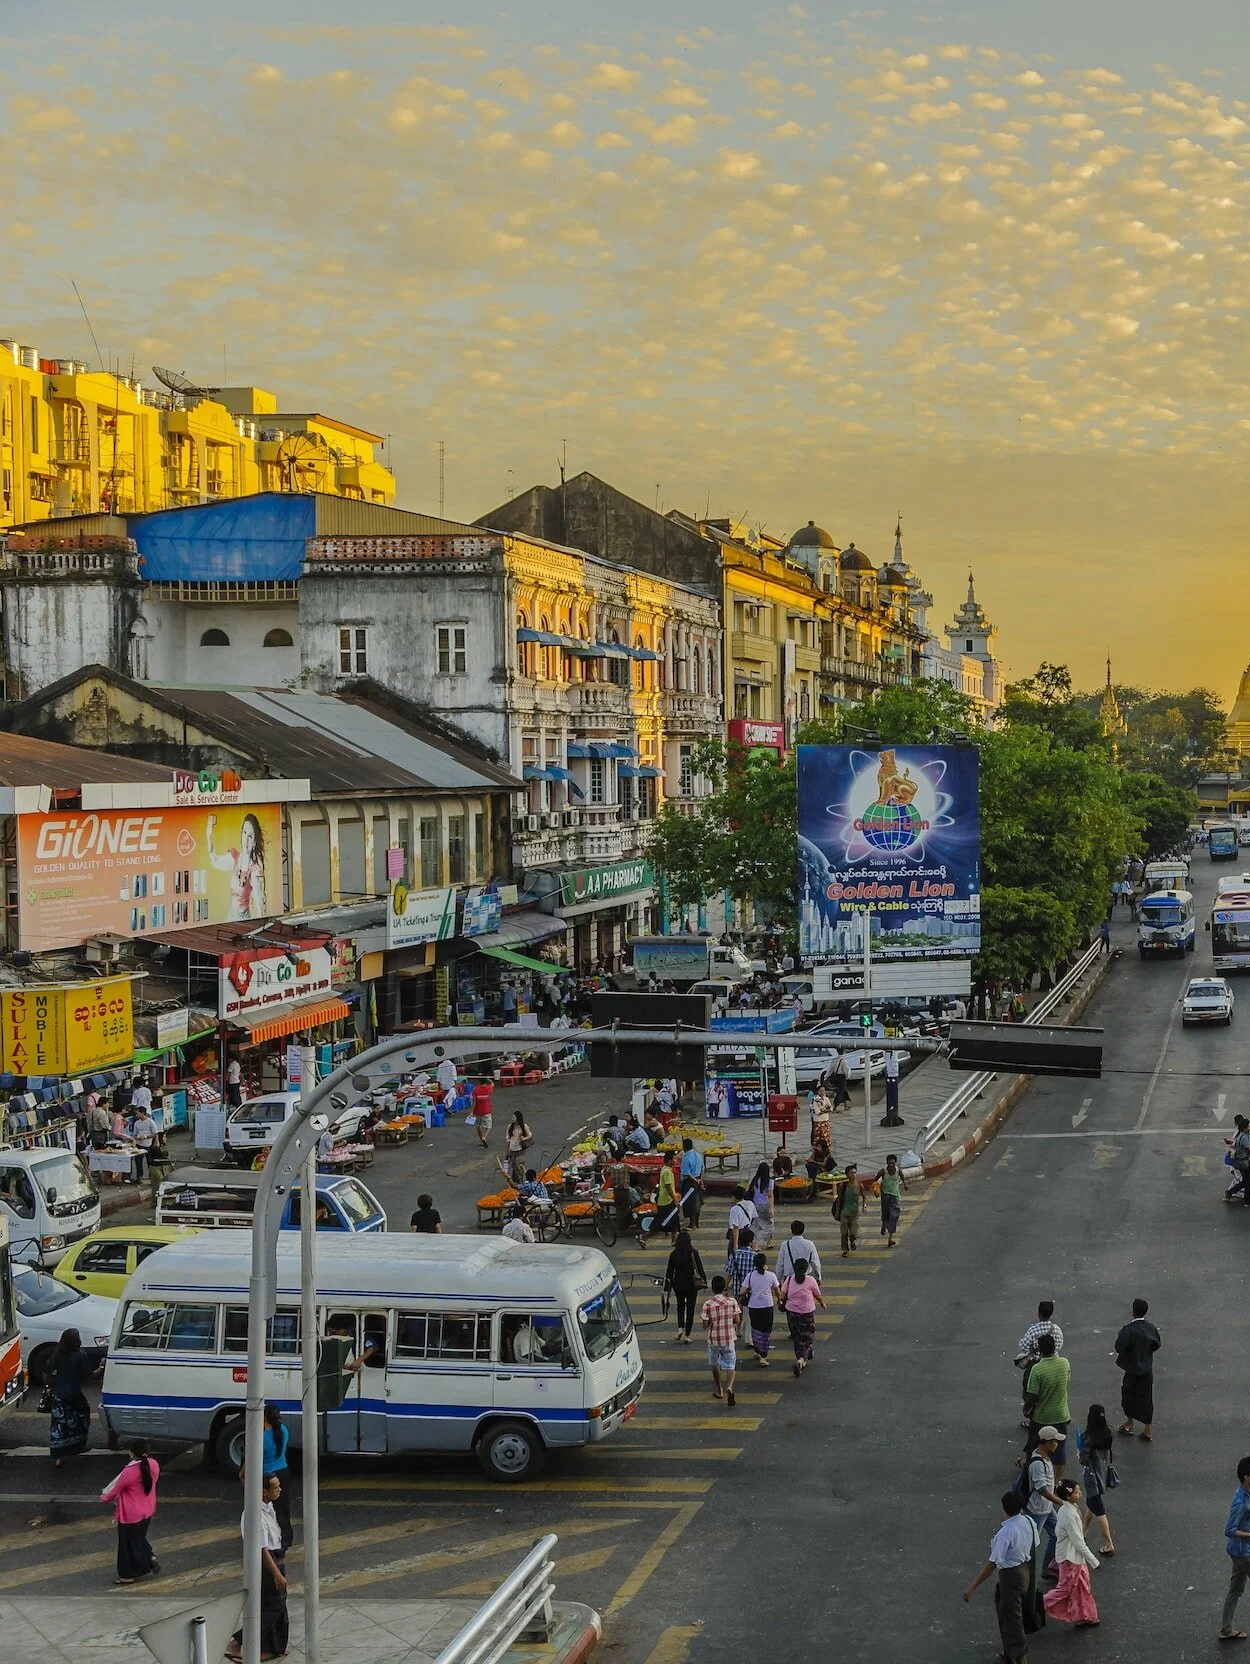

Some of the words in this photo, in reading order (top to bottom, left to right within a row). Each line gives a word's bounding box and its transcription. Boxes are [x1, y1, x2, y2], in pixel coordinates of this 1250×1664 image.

[176, 795, 189, 805] Sale
[197, 794, 218, 804] Service
[220, 793, 239, 803] Center
[853, 818, 899, 831] Golden
[904, 818, 930, 830] Lion
[34, 864, 65, 874] GOLDEN
[69, 860, 101, 871] QUALITY
[104, 858, 114, 868] TO
[116, 857, 141, 867] STAND
[143, 854, 161, 864] LONG
[890, 858, 907, 866] 1996
[602, 865, 645, 891] PHARMACY
[827, 881, 904, 900] Golden
[908, 880, 956, 898] Lion
[840, 902, 867, 912] Wire
[867, 902, 876, 911] &
[877, 900, 910, 911] Cable
[9, 992, 29, 1075] SULAY
[35, 996, 48, 1066] MOBILE
[59, 1216, 80, 1227] KHAING
